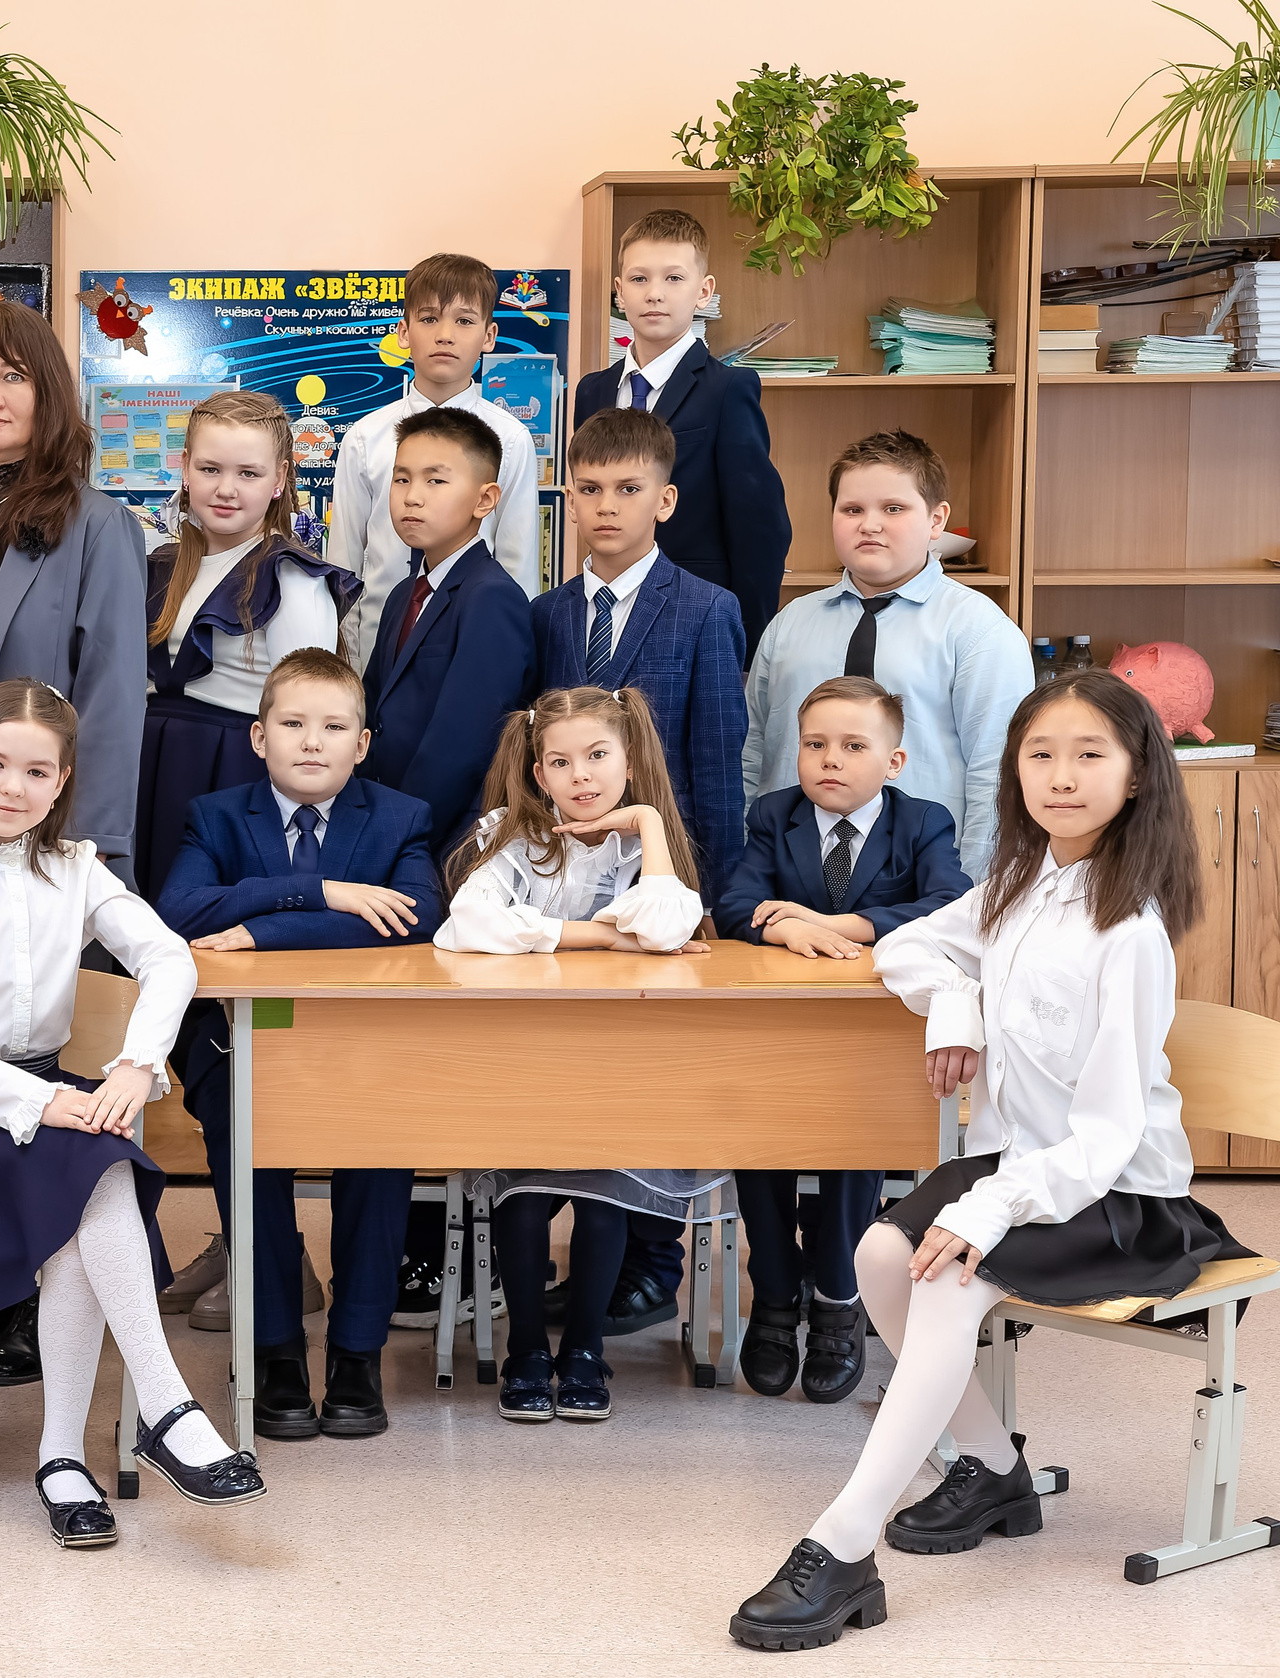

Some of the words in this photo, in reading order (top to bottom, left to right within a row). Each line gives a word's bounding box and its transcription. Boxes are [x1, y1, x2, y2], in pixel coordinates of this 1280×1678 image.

[169, 277, 286, 300] ЭКИПАЖ
[215, 306, 263, 318] Речёвка:
[265, 306, 300, 318] Очень
[302, 307, 348, 320] дружно
[351, 307, 367, 318] мы
[265, 324, 312, 337] Скучных
[316, 326, 323, 335] в
[325, 325, 369, 335] космос
[371, 325, 387, 335] не
[301, 405, 339, 416] Девиз:
[292, 424, 331, 433] только
[295, 442, 310, 450] не
[295, 478, 311, 486] ем
